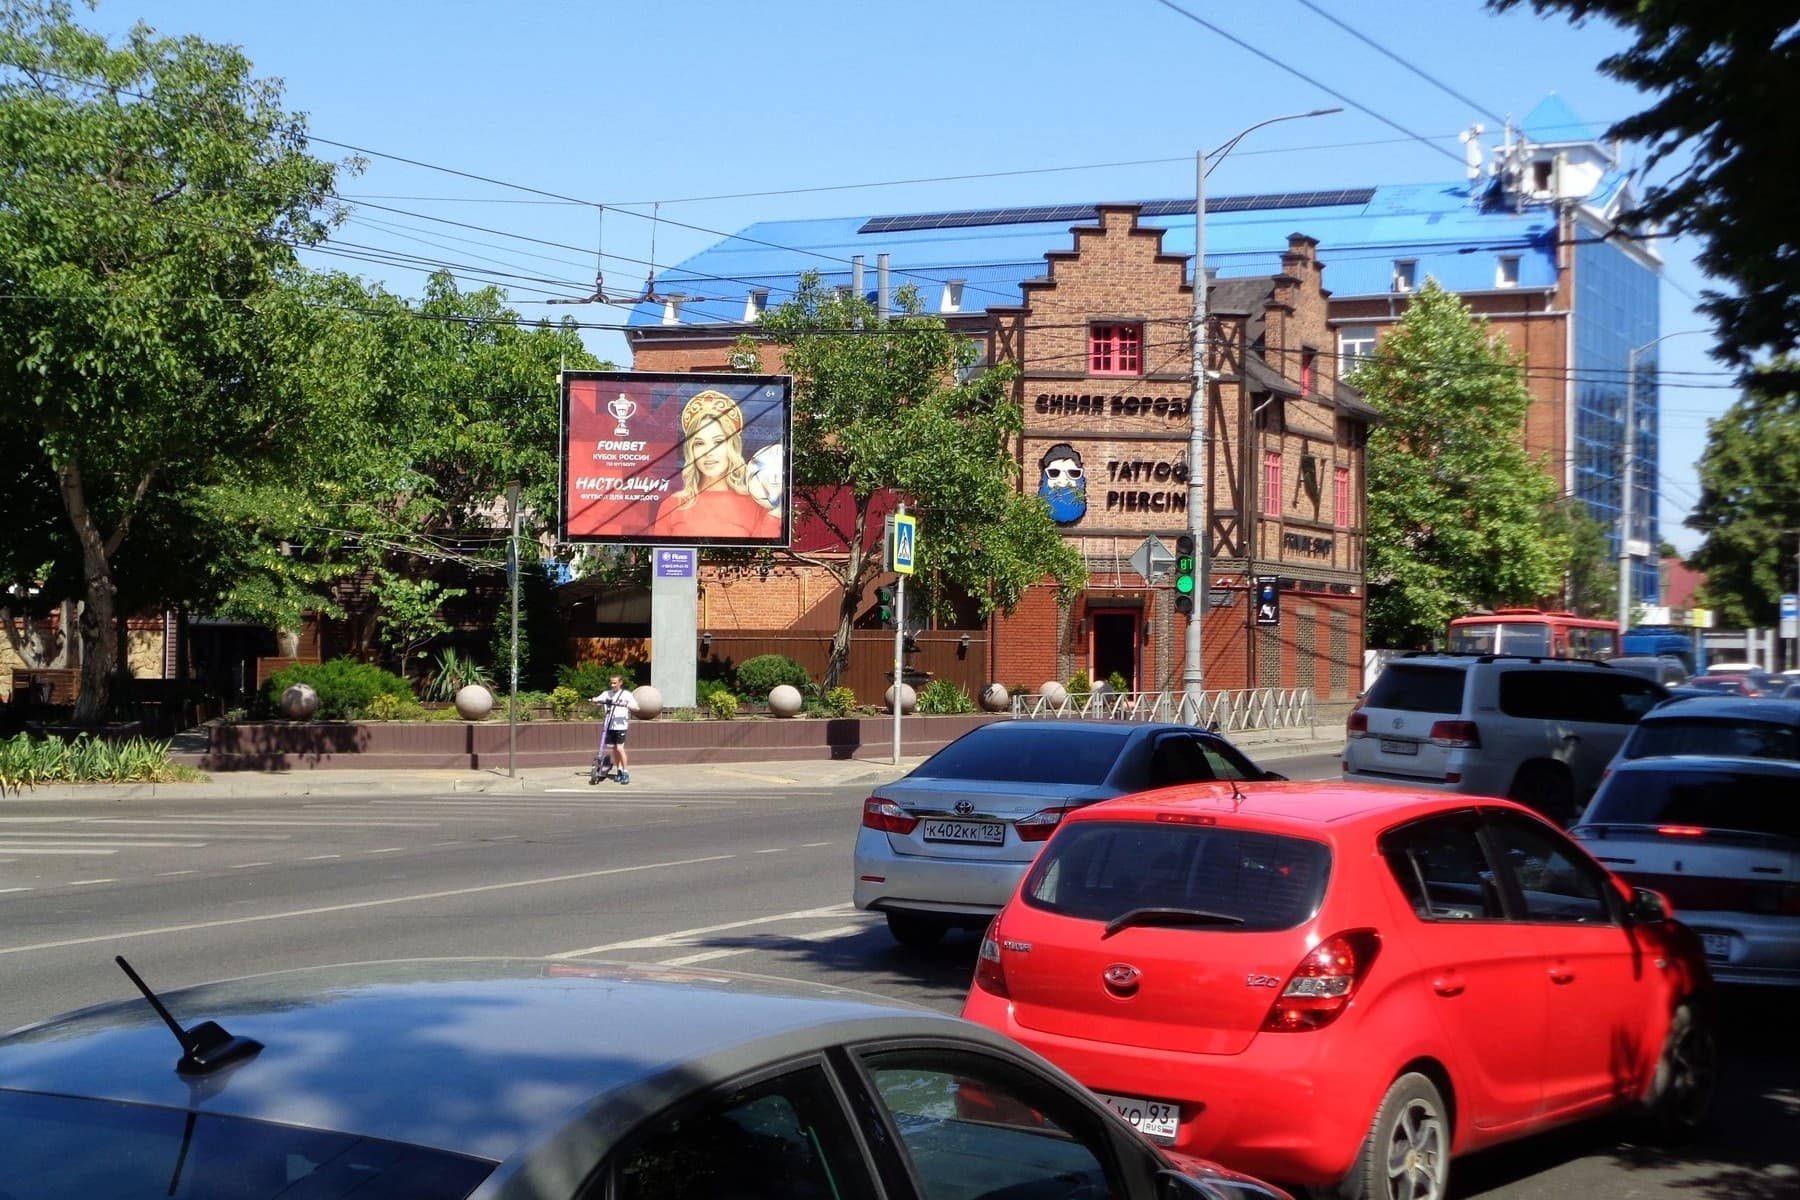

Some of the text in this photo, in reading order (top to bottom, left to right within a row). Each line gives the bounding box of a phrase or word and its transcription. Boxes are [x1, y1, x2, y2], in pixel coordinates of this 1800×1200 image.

[1034, 394, 1193, 420] СИНЯЯ БОРОД
[597, 440, 647, 451] FONBET
[592, 453, 650, 462] КУБОК РОССИИ
[1107, 461, 1189, 484] TATTOO
[575, 476, 670, 493] НАСТОЯЩИЙ
[580, 493, 660, 502] ФУТБОЛ ДЛЯ КАЖДОГО
[1106, 490, 1187, 513] PIERCIN
[1149, 1104, 1171, 1125] 93
[1145, 1122, 1162, 1133] RUS
